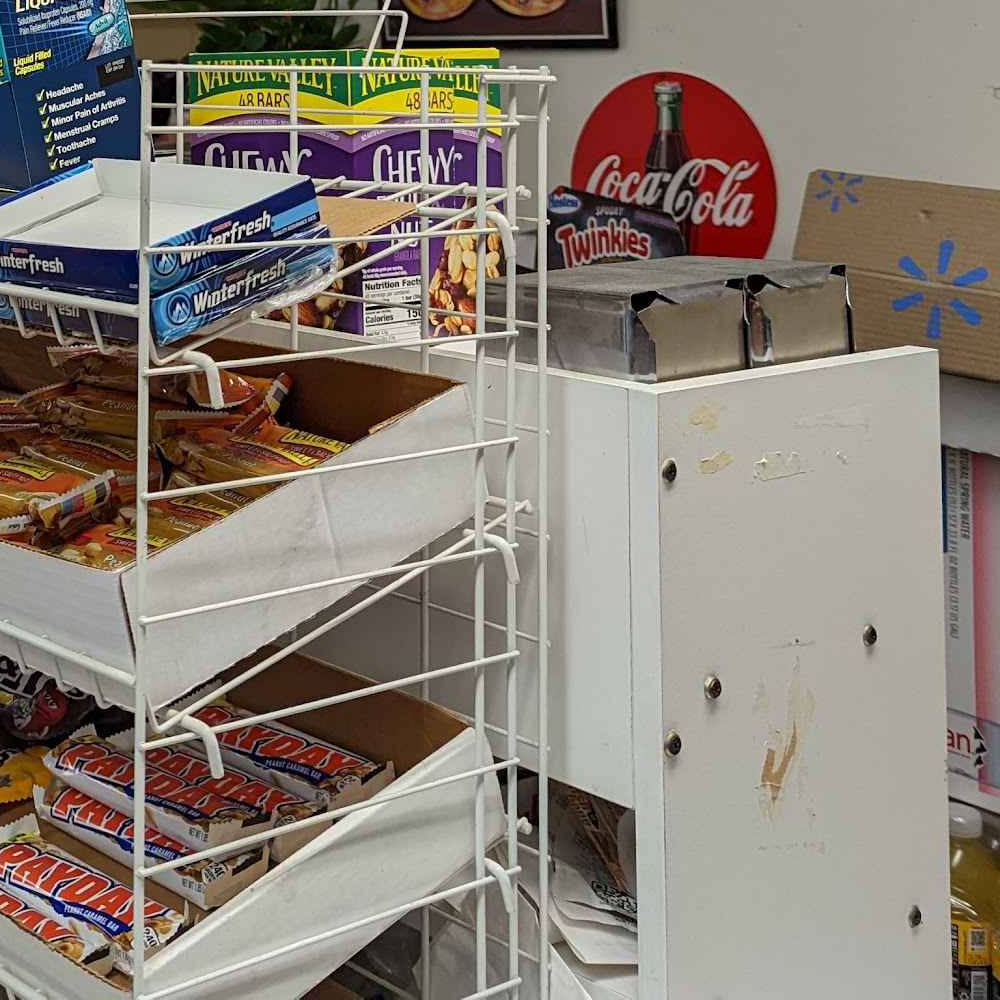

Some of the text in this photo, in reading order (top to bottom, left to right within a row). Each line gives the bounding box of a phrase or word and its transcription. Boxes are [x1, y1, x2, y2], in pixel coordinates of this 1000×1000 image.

[13, 48, 52, 67] Liquid Filled
[15, 61, 45, 76] Capsules
[196, 57, 337, 97] NATURE VALLEY
[46, 82, 84, 99] Headache
[238, 91, 291, 108] 48 BARS
[48, 89, 106, 113] Muscular Aches
[405, 91, 421, 110] 48
[50, 96, 126, 127] Minor Pain of Arthritis
[53, 114, 119, 141] Menstrual Cramps
[55, 135, 96, 154] Toothache
[59, 155, 81, 169] Fever
[586, 154, 760, 229] Coca-Cola
[595, 205, 624, 217] SPOOKY
[555, 220, 653, 269] Twinkies
[193, 258, 286, 315] Winterfresh
[364, 277, 422, 291] Nutrition Facts
[365, 315, 394, 324] Calories
[56, 453, 87, 468] Peanut
[959, 483, 970, 540] SPRING WATER
[265, 758, 322, 781] PEANUT CARAMEL BAR
[64, 903, 119, 933] PEANUT CARAMEL BAR
